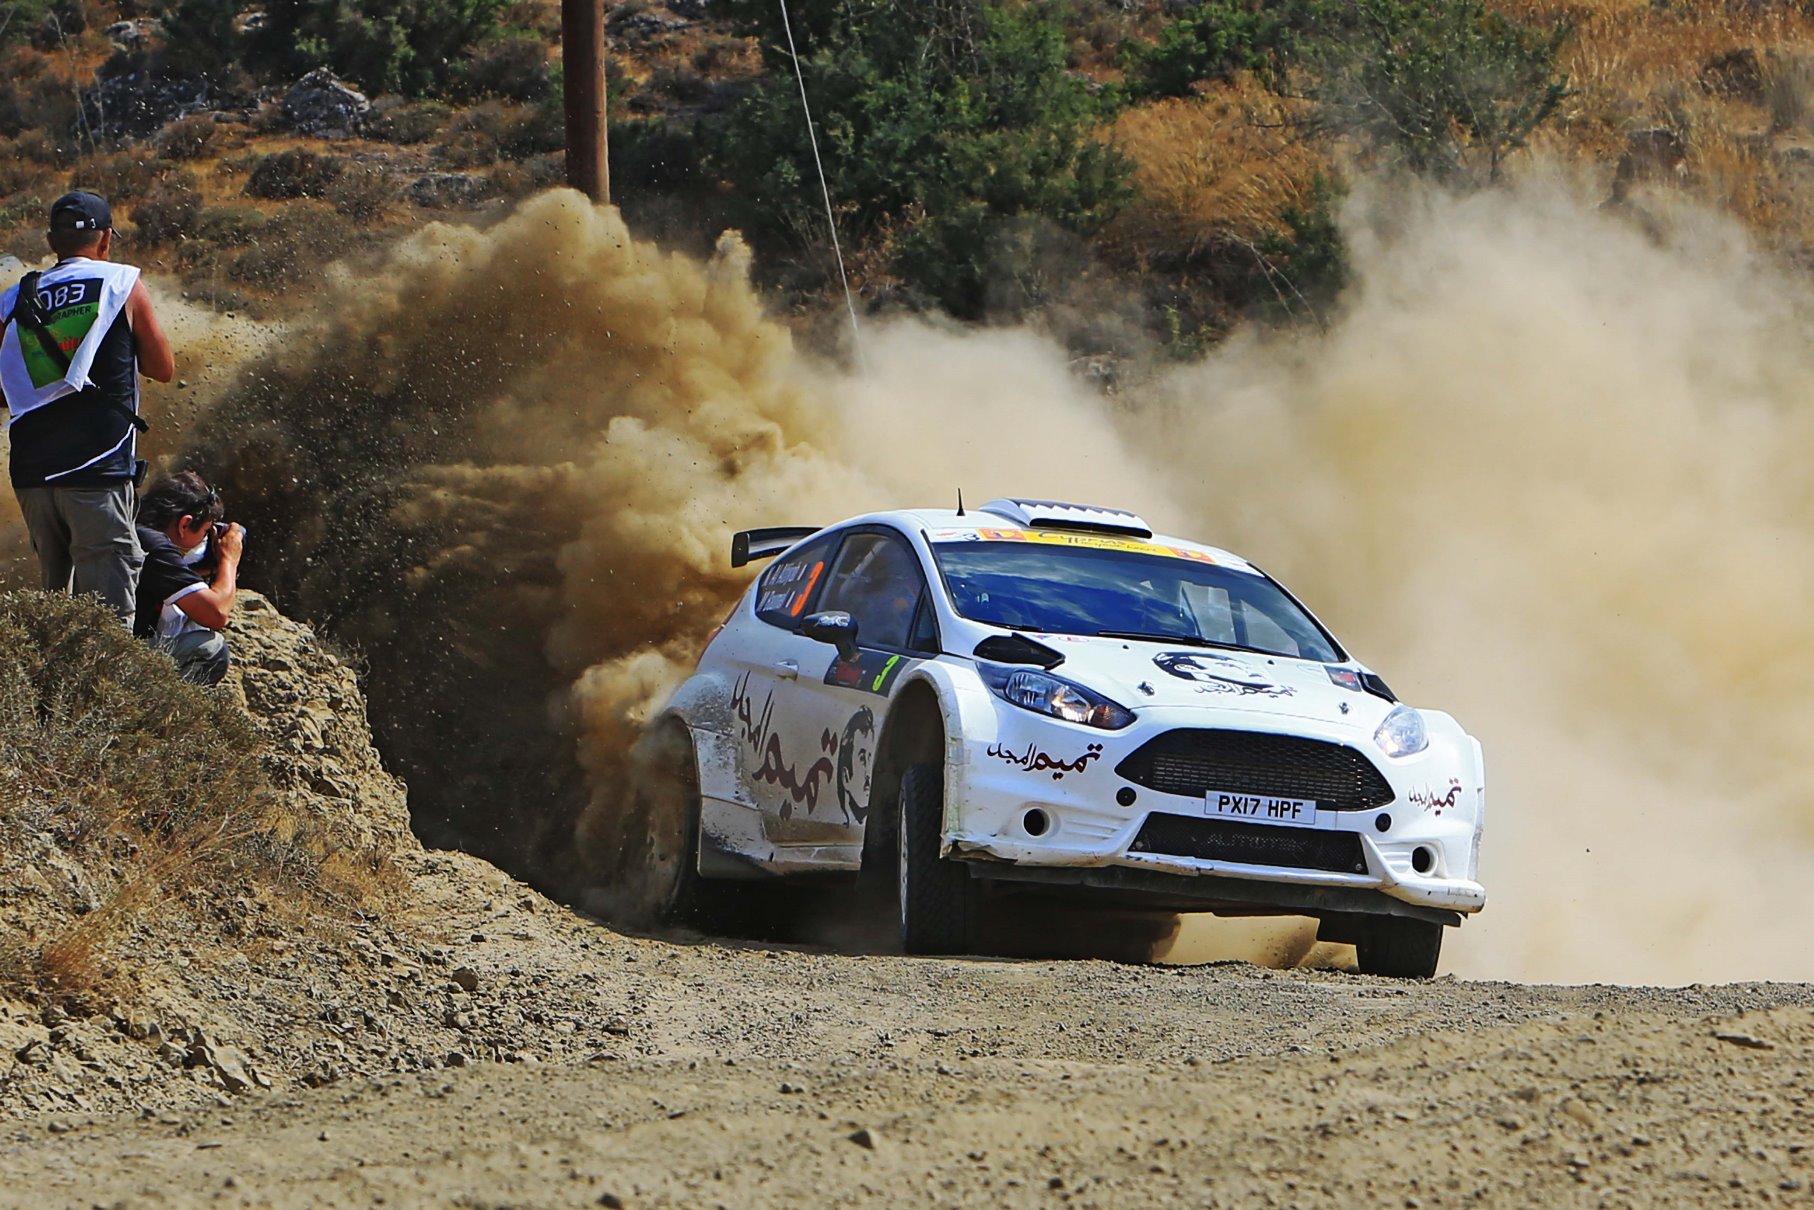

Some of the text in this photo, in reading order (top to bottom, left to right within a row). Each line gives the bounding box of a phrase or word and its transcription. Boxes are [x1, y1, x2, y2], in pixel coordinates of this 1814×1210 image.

[791, 561, 824, 617] 3
[872, 655, 900, 692] 3
[1022, 743, 1104, 780] تميم
[1218, 795, 1304, 819] PX17 HPF
